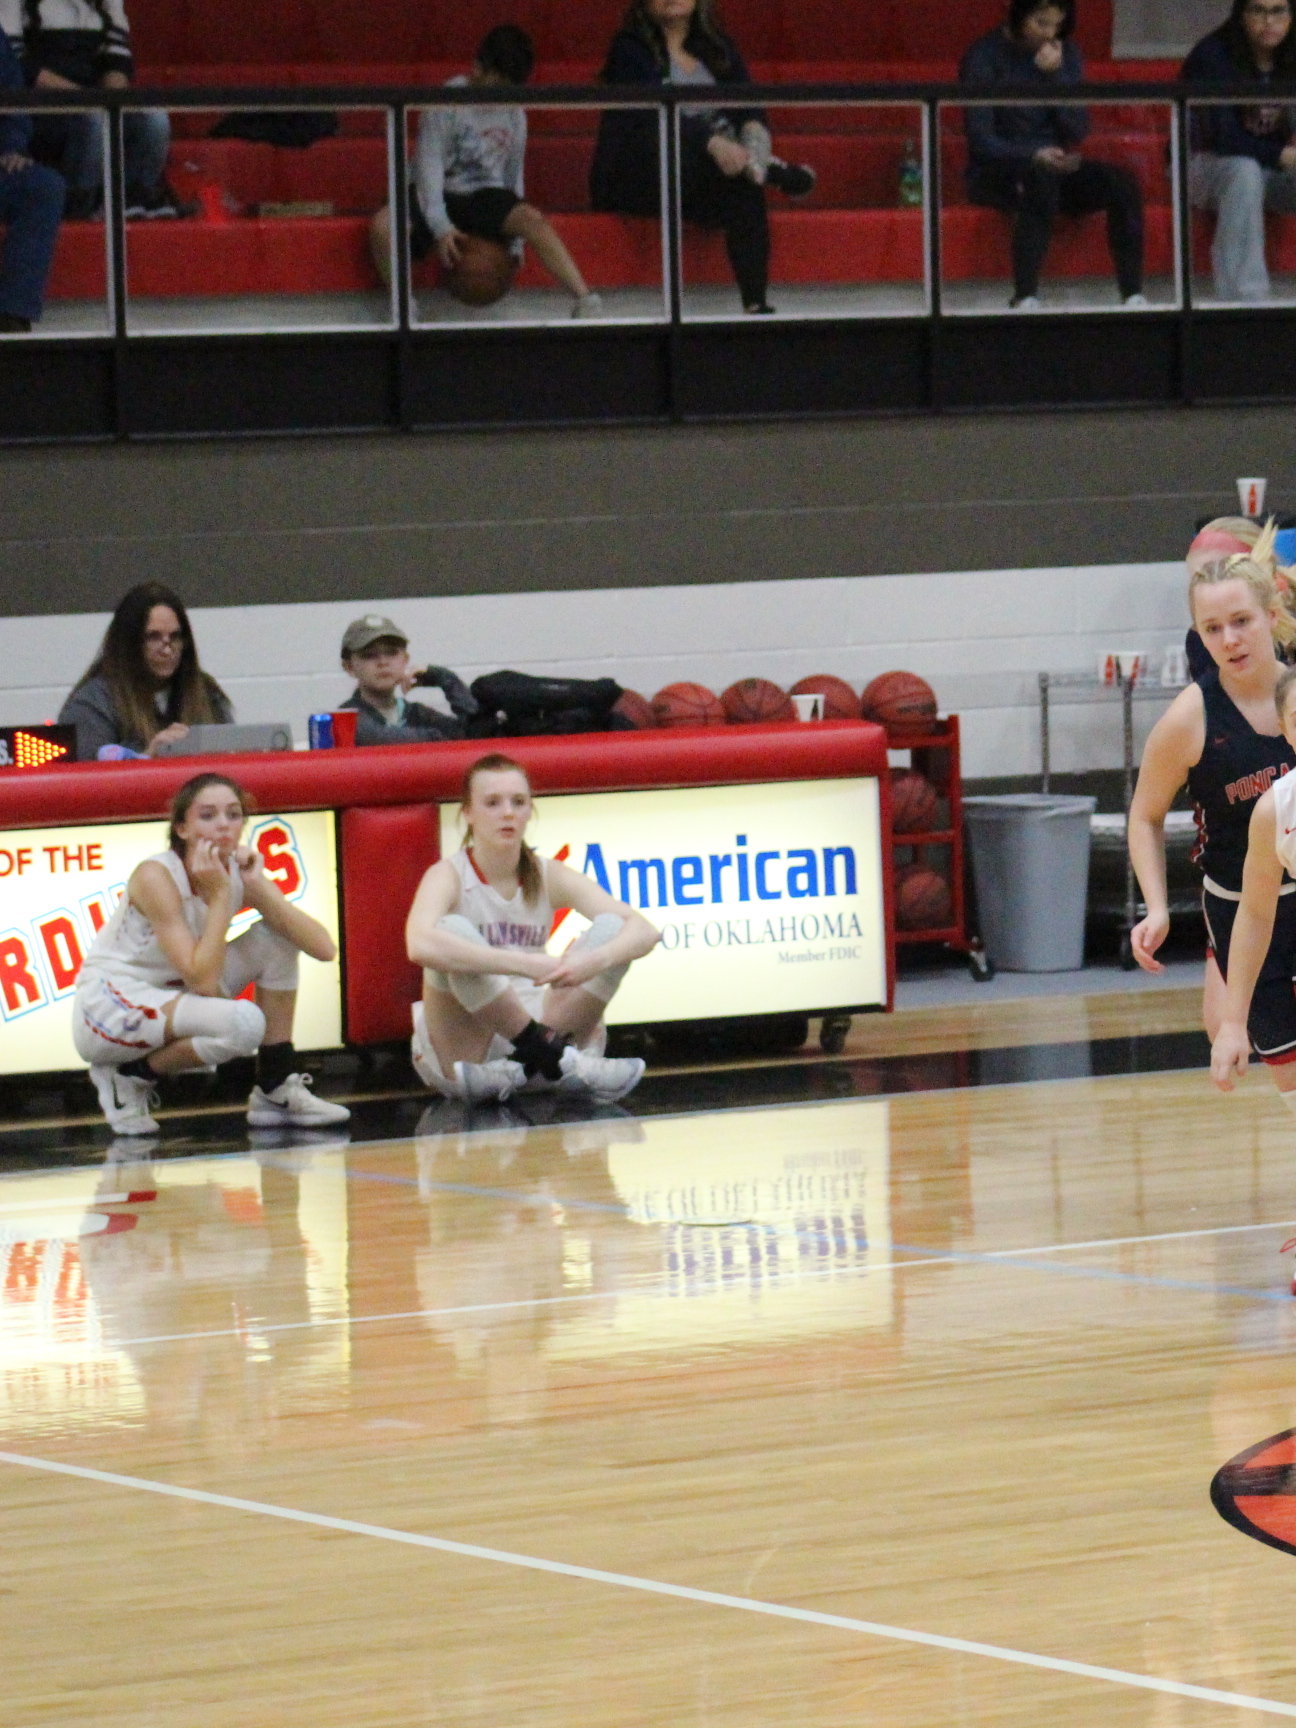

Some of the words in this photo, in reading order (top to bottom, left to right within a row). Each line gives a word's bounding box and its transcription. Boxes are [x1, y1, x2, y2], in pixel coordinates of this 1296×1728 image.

[43, 843, 103, 873] THE
[583, 834, 858, 908] American
[661, 922, 696, 951] OF
[703, 911, 864, 948] OKLAHOMA
[777, 949, 827, 965] Member
[828, 944, 862, 962] FDIC
